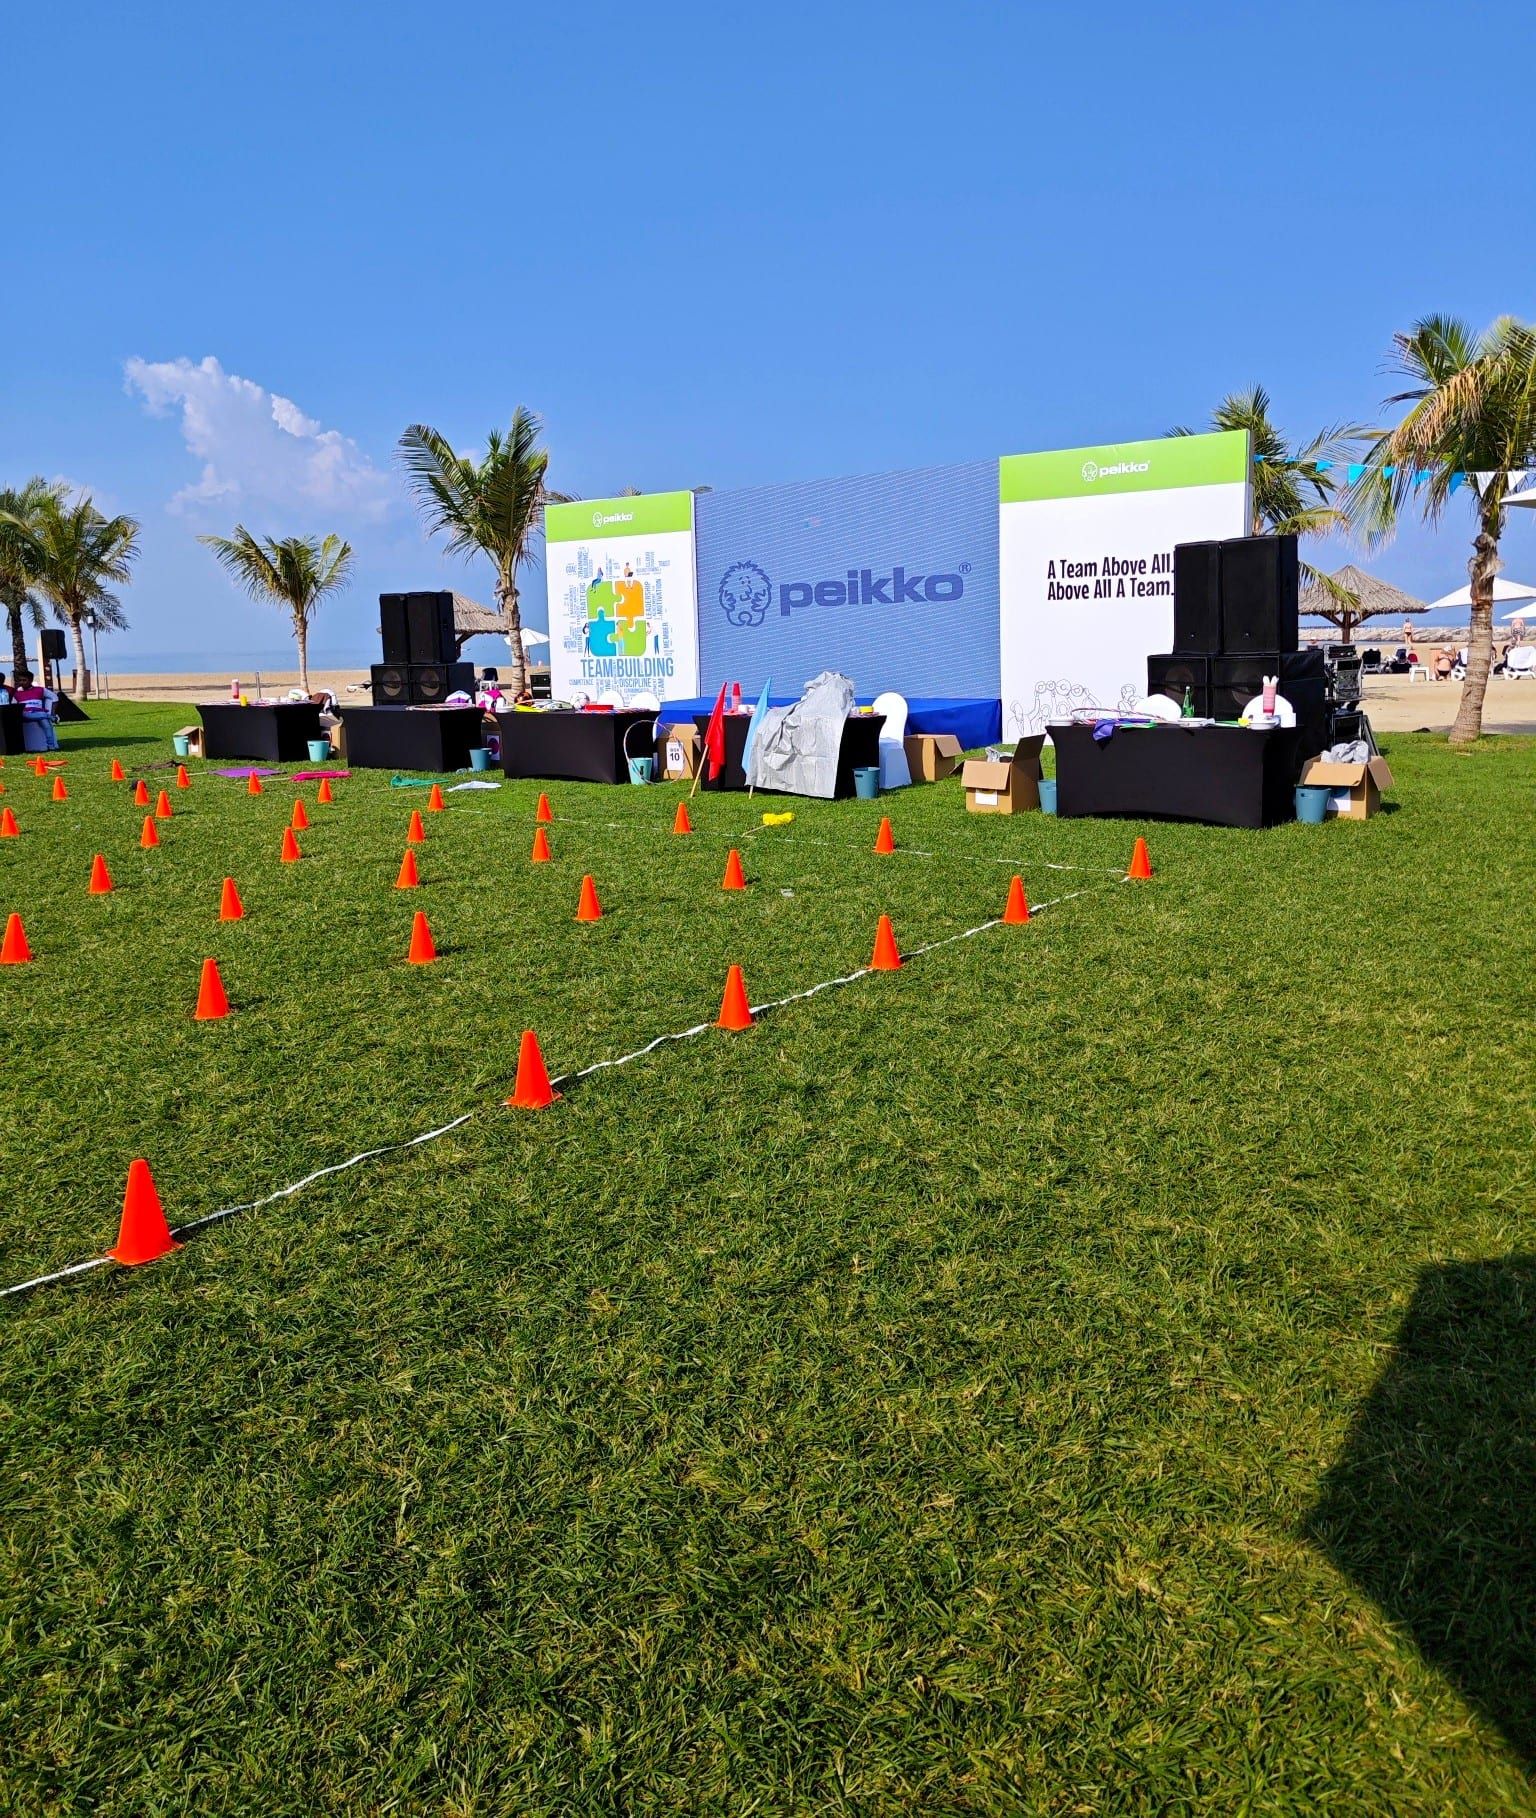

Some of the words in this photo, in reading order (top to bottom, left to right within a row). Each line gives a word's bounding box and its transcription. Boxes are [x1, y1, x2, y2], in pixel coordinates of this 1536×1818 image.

[1099, 461, 1149, 477] peikko
[1047, 560, 1056, 579] A
[1060, 559, 1098, 578] Team
[1102, 557, 1147, 576] Above
[1151, 553, 1175, 574] All.
[655, 578, 663, 618] MOTIVATION
[1047, 581, 1090, 601] Above
[1094, 579, 1112, 599] All
[1116, 578, 1126, 598] A
[1130, 577, 1175, 597] Team.
[644, 581, 652, 620] LEADERSHIP
[580, 658, 613, 677] TEAM
[616, 657, 674, 677] BUILDING
[619, 677, 651, 688] DISCIPLINE
[669, 752, 680, 761] 10
